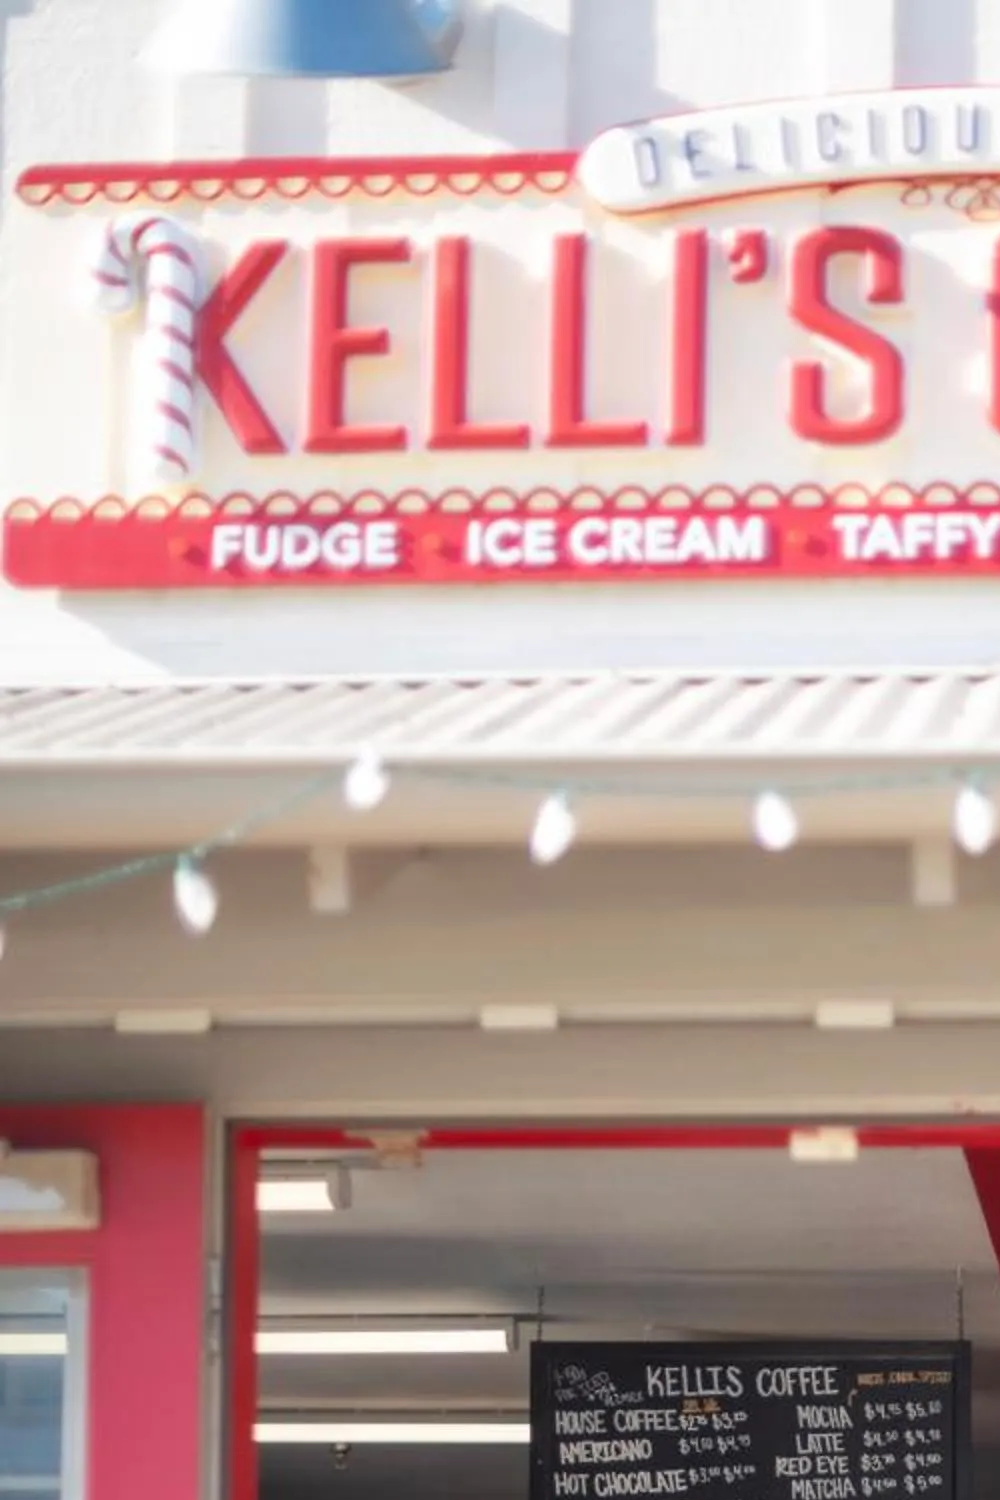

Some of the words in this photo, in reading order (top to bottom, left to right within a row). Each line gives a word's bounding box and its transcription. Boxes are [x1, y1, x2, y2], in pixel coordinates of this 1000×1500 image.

[195, 226, 906, 456] KELLI'S
[210, 518, 400, 569] FUDGE
[466, 517, 562, 565] ICE
[569, 515, 768, 564] CREAM
[756, 1366, 839, 1397] COFFEE
[555, 1409, 607, 1434] HOUSE
[613, 1409, 679, 1432] COFFEE
[797, 1405, 853, 1428] MOCHA
[559, 1439, 653, 1464] AMERICANO
[796, 1433, 845, 1454] LATTE
[775, 1456, 811, 1477] RED
[816, 1456, 849, 1474] EYE
[554, 1472, 589, 1496] HOT
[594, 1469, 689, 1496] CHOCOLATE
[791, 1476, 857, 1500] MATCHA
